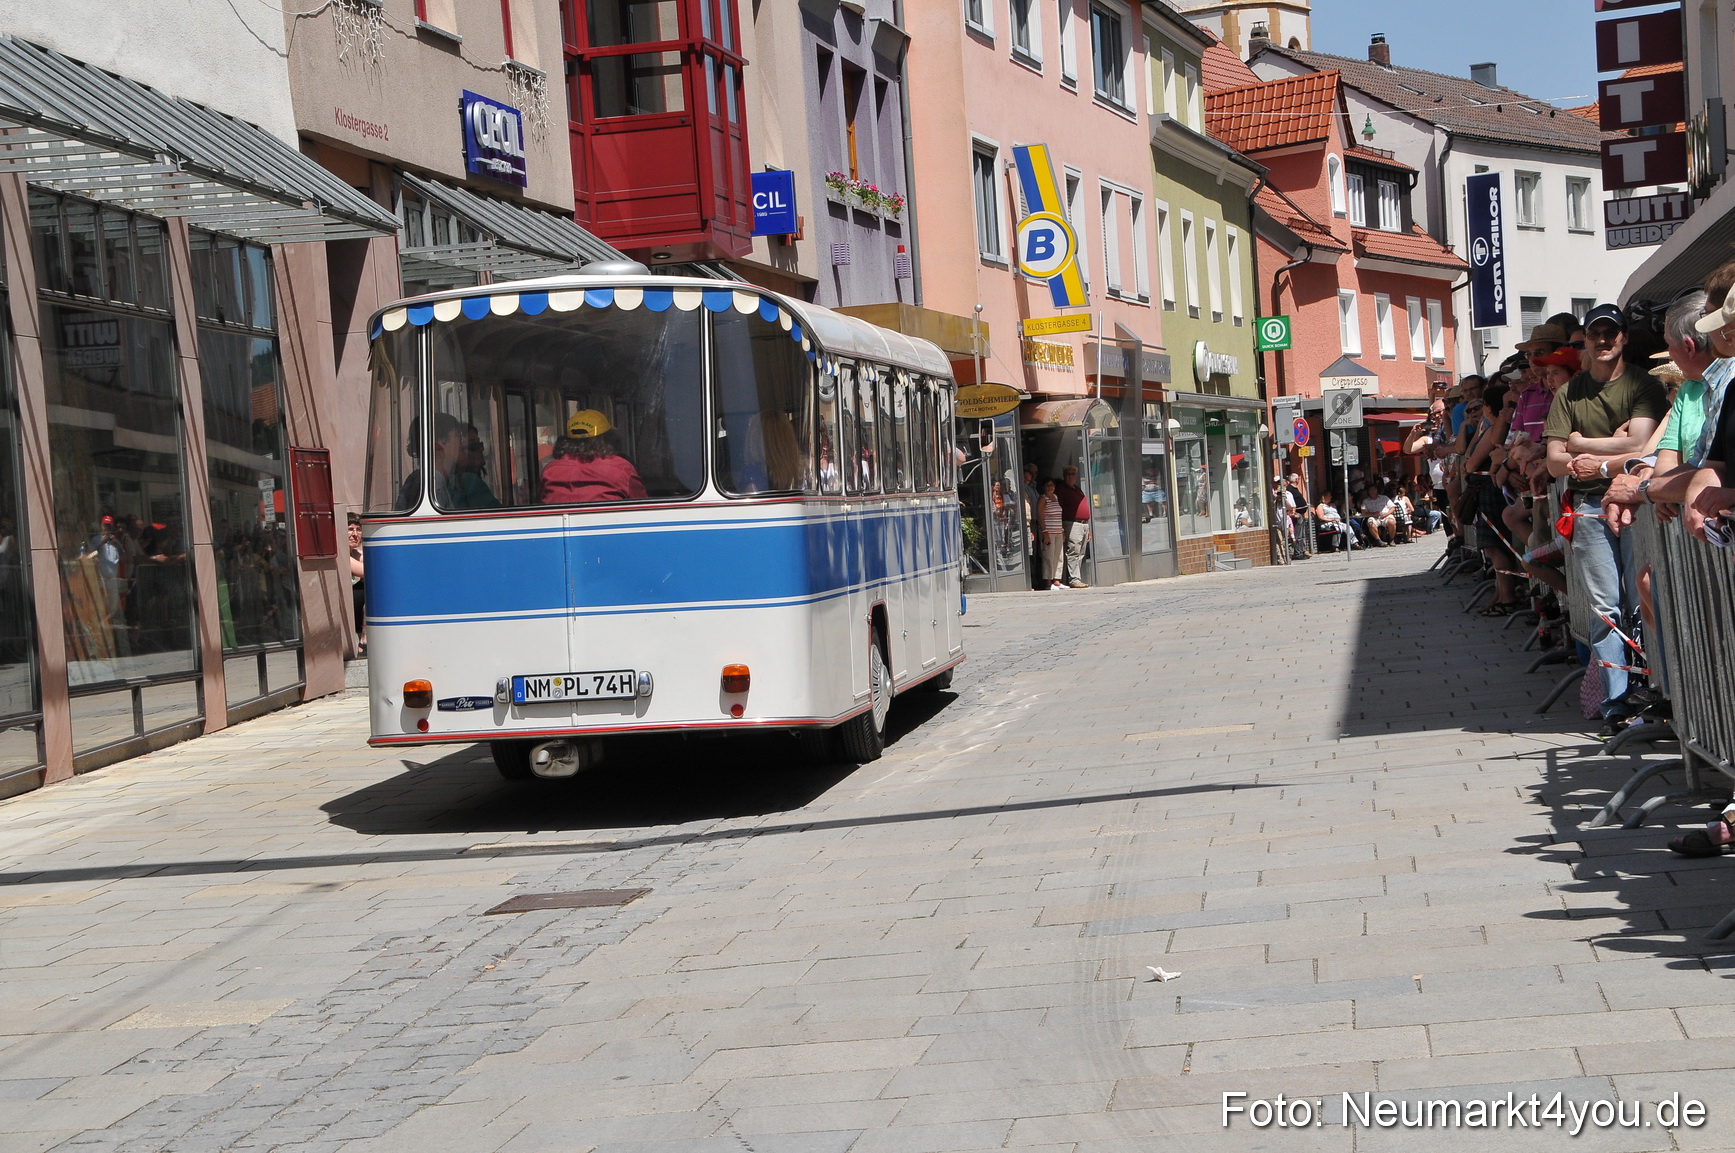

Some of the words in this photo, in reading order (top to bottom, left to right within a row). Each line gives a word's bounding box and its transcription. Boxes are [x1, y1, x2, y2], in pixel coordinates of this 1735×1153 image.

[1604, 0, 1657, 183] ITT
[334, 106, 384, 139] Klostergasse
[383, 123, 389, 142] 2
[1489, 187, 1500, 258] TAILOR
[1606, 194, 1684, 225] WITT
[1025, 228, 1055, 262] B
[1492, 261, 1504, 313] TOM
[1026, 319, 1080, 331] KLOSTERGASSE
[1331, 377, 1368, 388] Creppresso
[1334, 417, 1353, 425] ZONE
[525, 678, 551, 698] NM
[564, 677, 589, 696] PL
[593, 674, 633, 695] 74H
